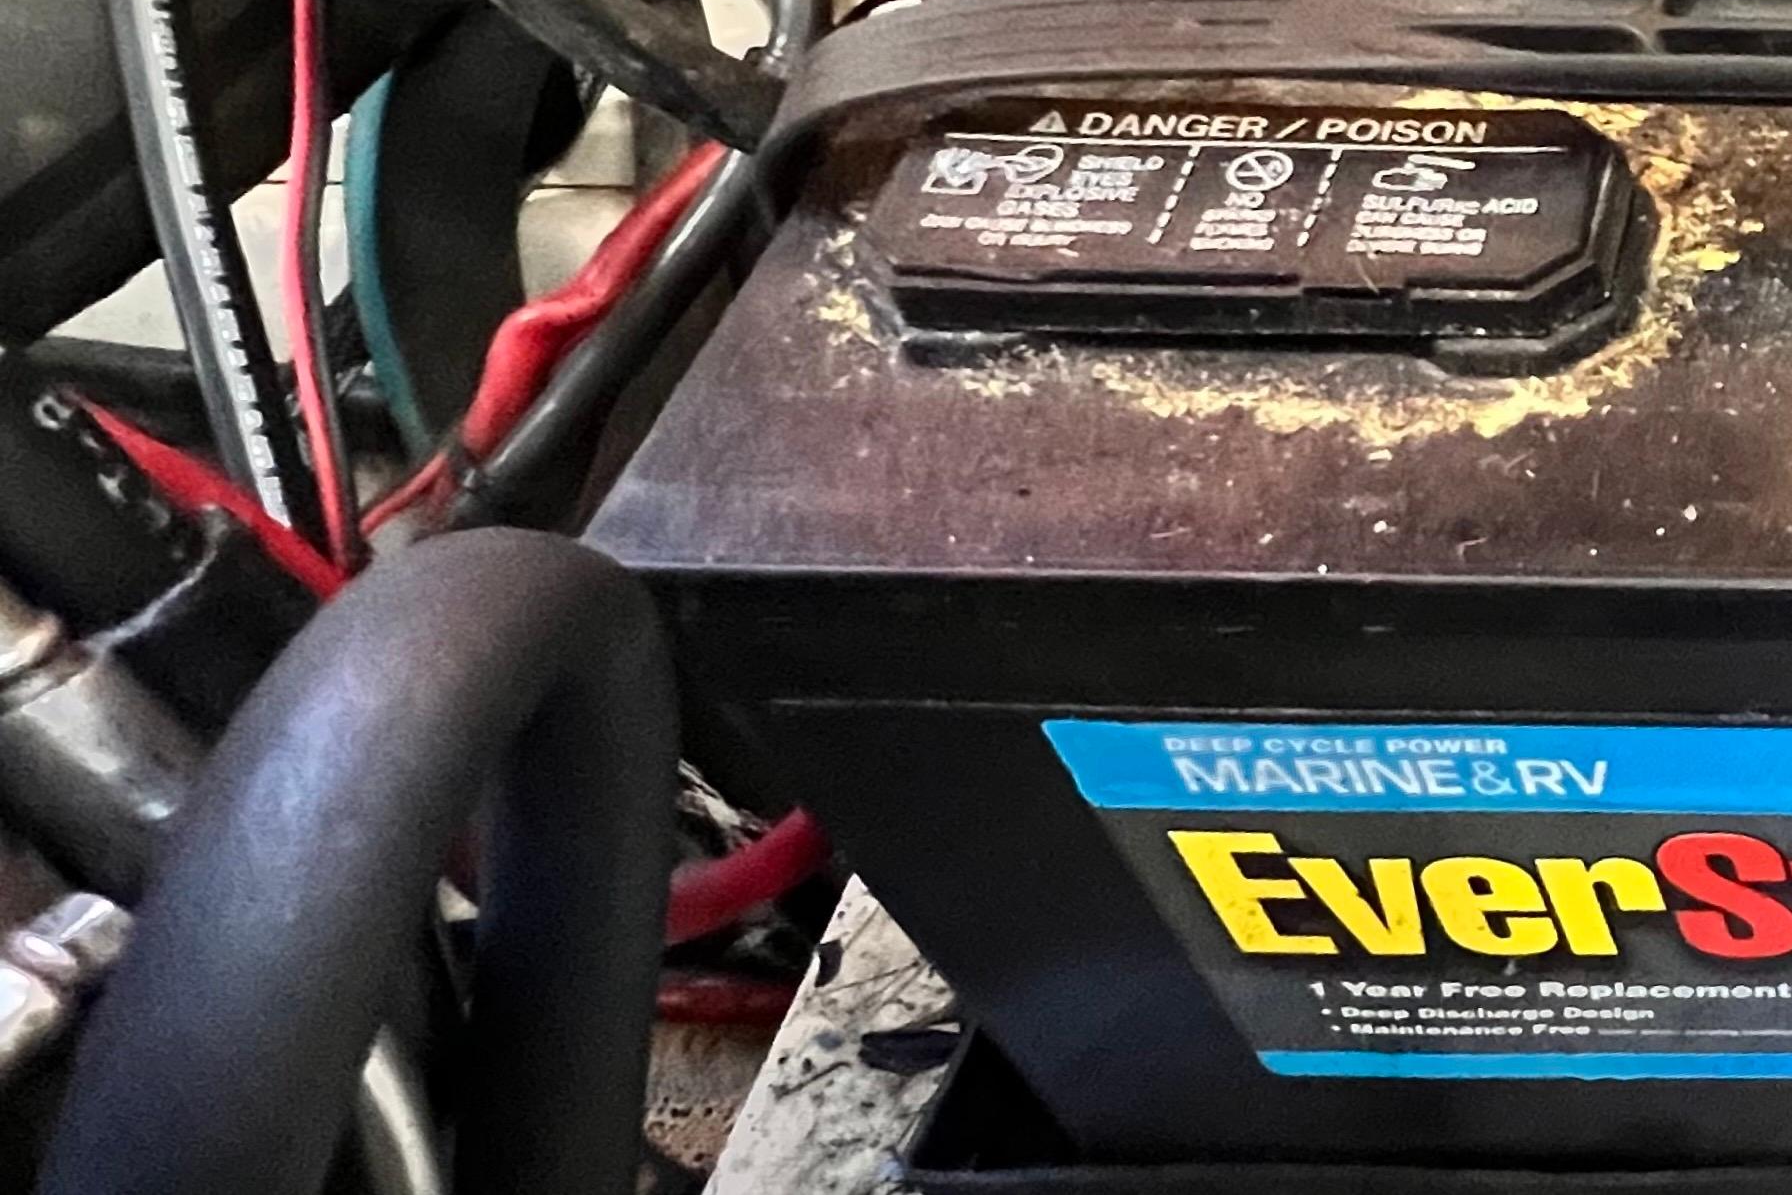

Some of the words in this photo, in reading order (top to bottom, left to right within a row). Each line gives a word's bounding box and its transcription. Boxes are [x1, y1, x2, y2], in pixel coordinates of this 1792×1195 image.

[1077, 111, 1269, 139] DANGER
[1275, 117, 1309, 139] /
[1316, 117, 1488, 144] POISON
[1224, 191, 1265, 209] NO
[1481, 197, 1540, 215] ACID
[1163, 736, 1253, 754] DEEP
[1264, 737, 1375, 755] CYCLE
[1386, 737, 1508, 755] POWER
[1308, 982, 1326, 998] 1
[1340, 981, 1428, 998] Year
[1440, 981, 1526, 998] Free
[1539, 981, 1792, 1001] Replacement
[1341, 1006, 1410, 1021] Deep
[1417, 1006, 1555, 1022] Discharge
[1563, 1006, 1655, 1021] Design
[1349, 1023, 1523, 1036] Maintenance
[1532, 1023, 1591, 1035] Free
